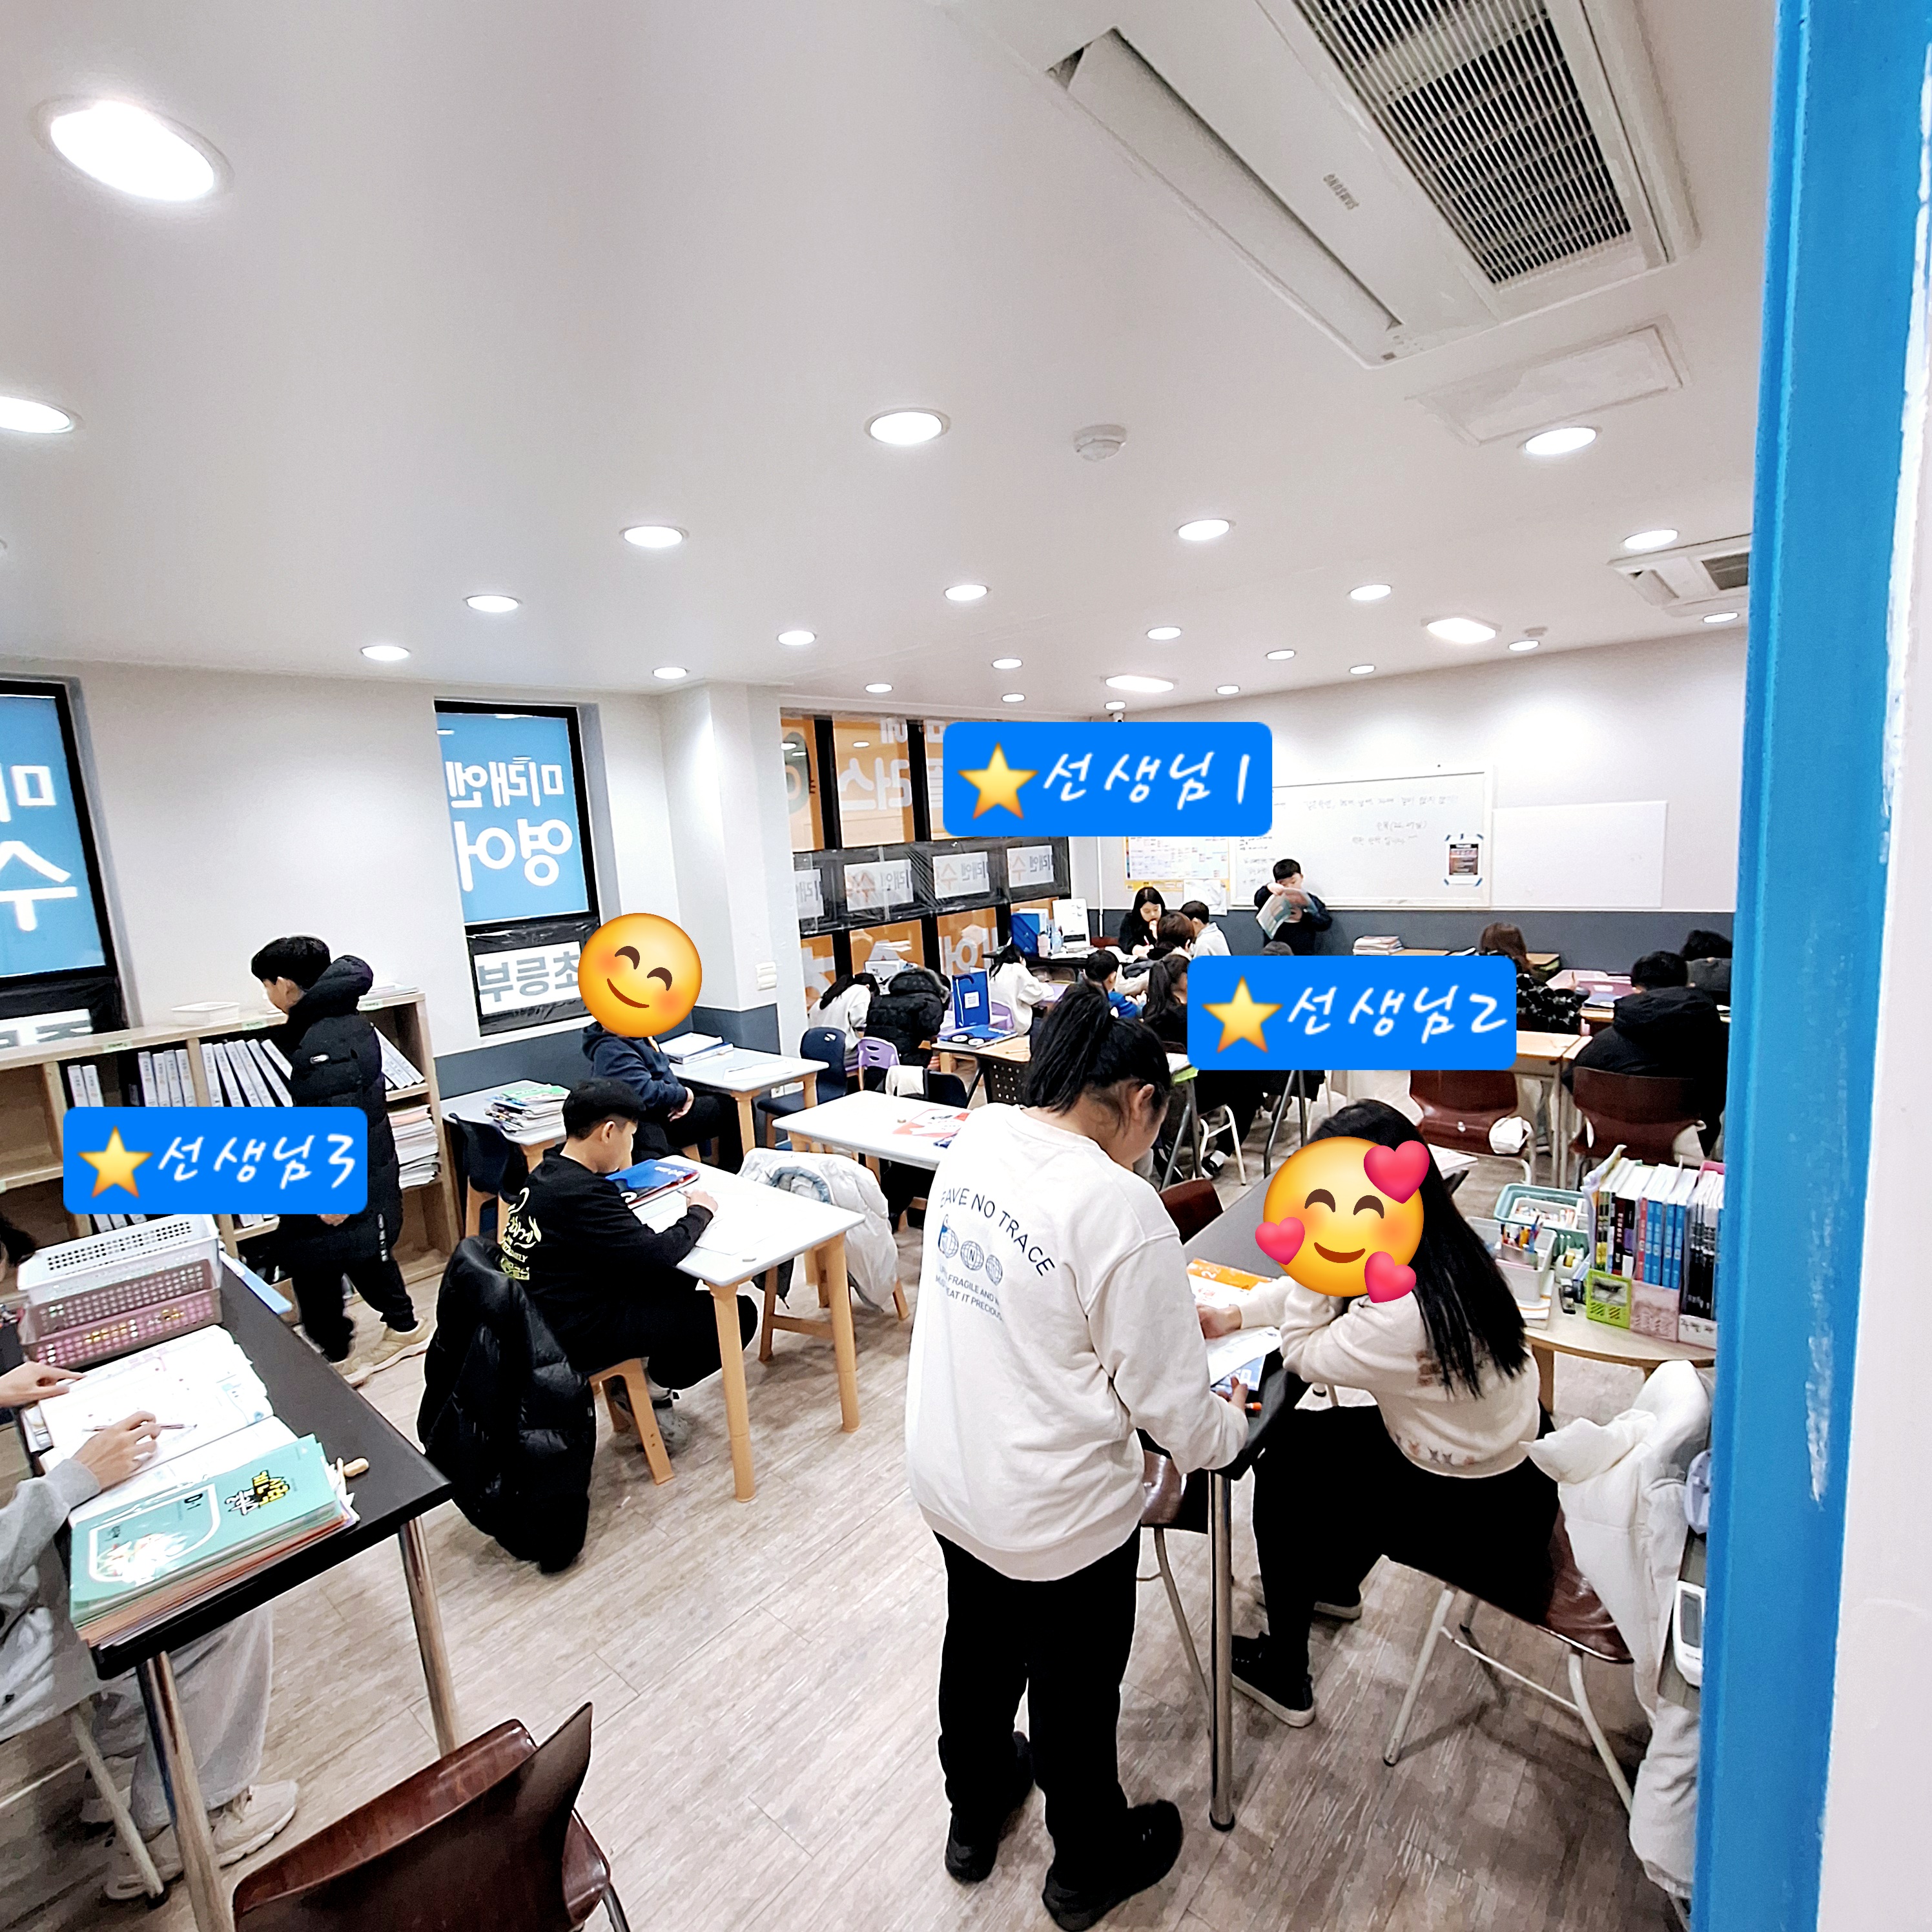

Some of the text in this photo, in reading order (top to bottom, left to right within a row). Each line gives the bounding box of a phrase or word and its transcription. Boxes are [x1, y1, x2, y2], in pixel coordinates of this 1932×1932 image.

[1323, 174, 1359, 210] SAMSUNG
[971, 1193, 995, 1218] NO
[998, 1210, 1056, 1277] TRACE
[948, 1274, 979, 1293] FRAGILE
[980, 1289, 994, 1302] AND
[961, 1293, 971, 1302] IT
